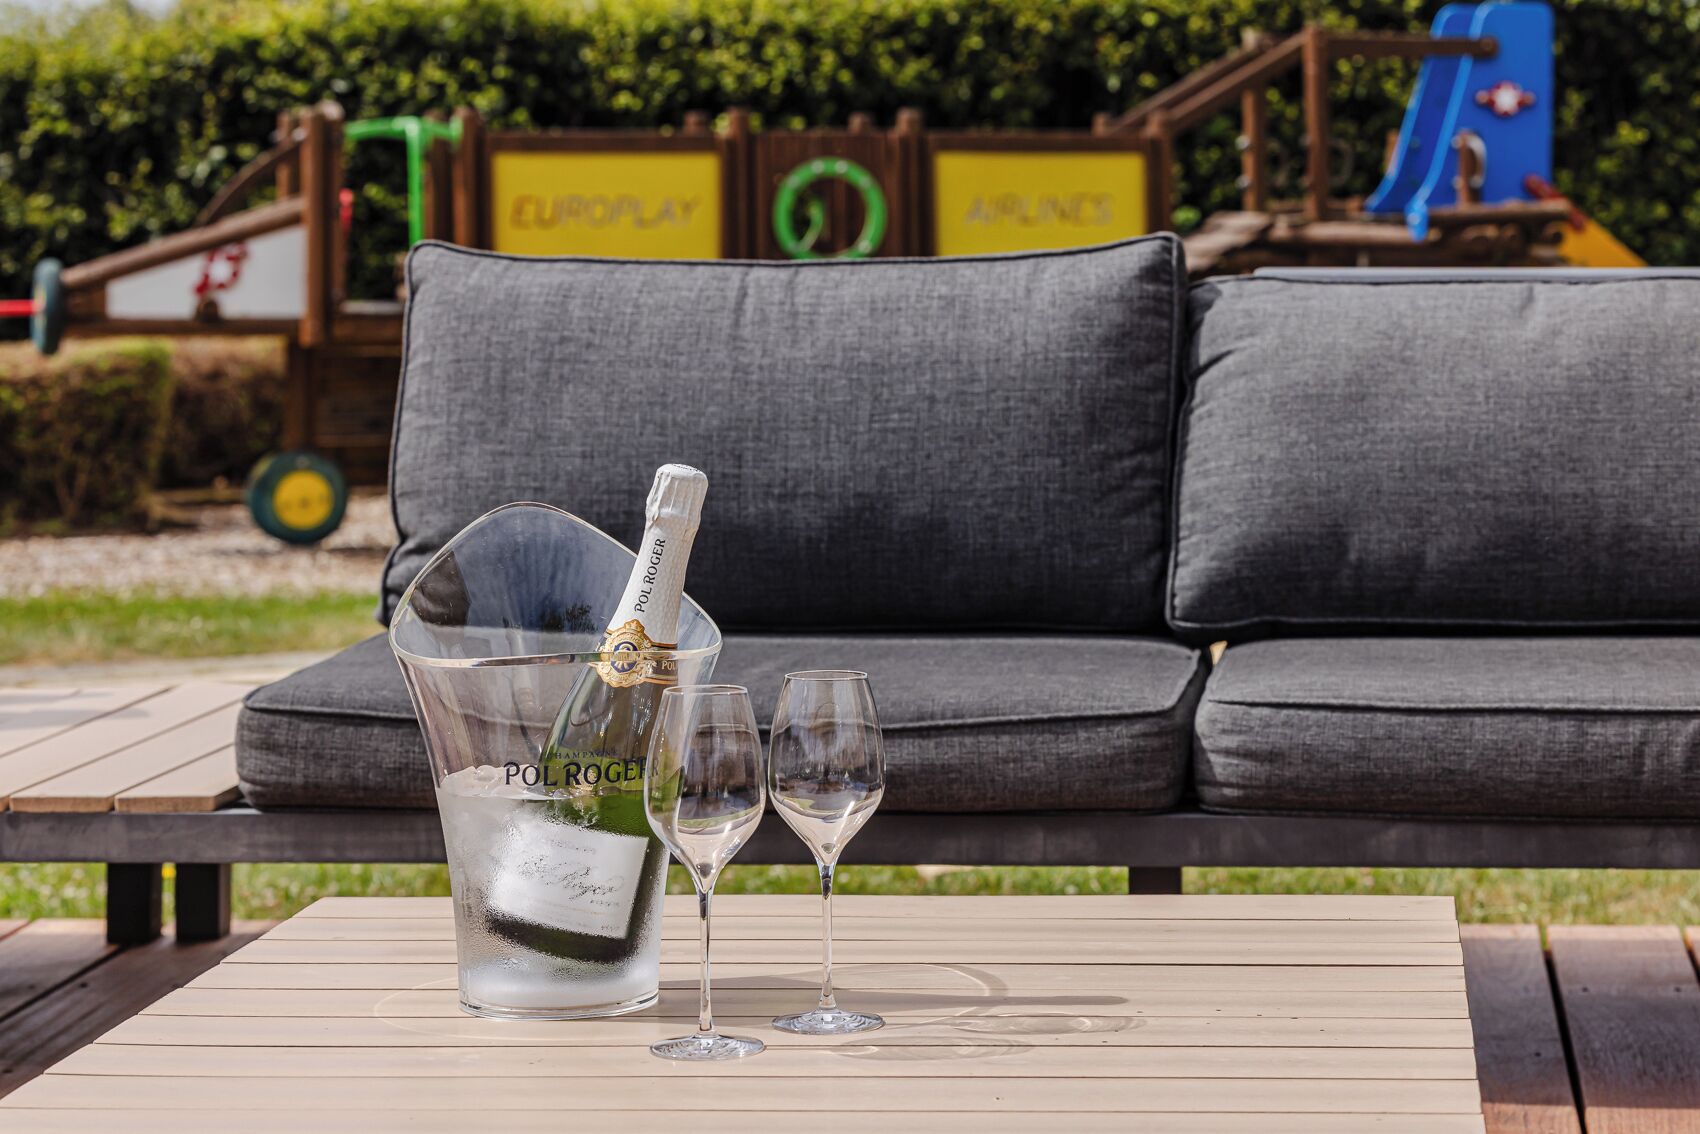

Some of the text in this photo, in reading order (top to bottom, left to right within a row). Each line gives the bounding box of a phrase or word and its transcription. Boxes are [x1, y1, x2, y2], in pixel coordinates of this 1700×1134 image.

[635, 538, 666, 612] POL ROGER
[503, 761, 558, 787] POL
